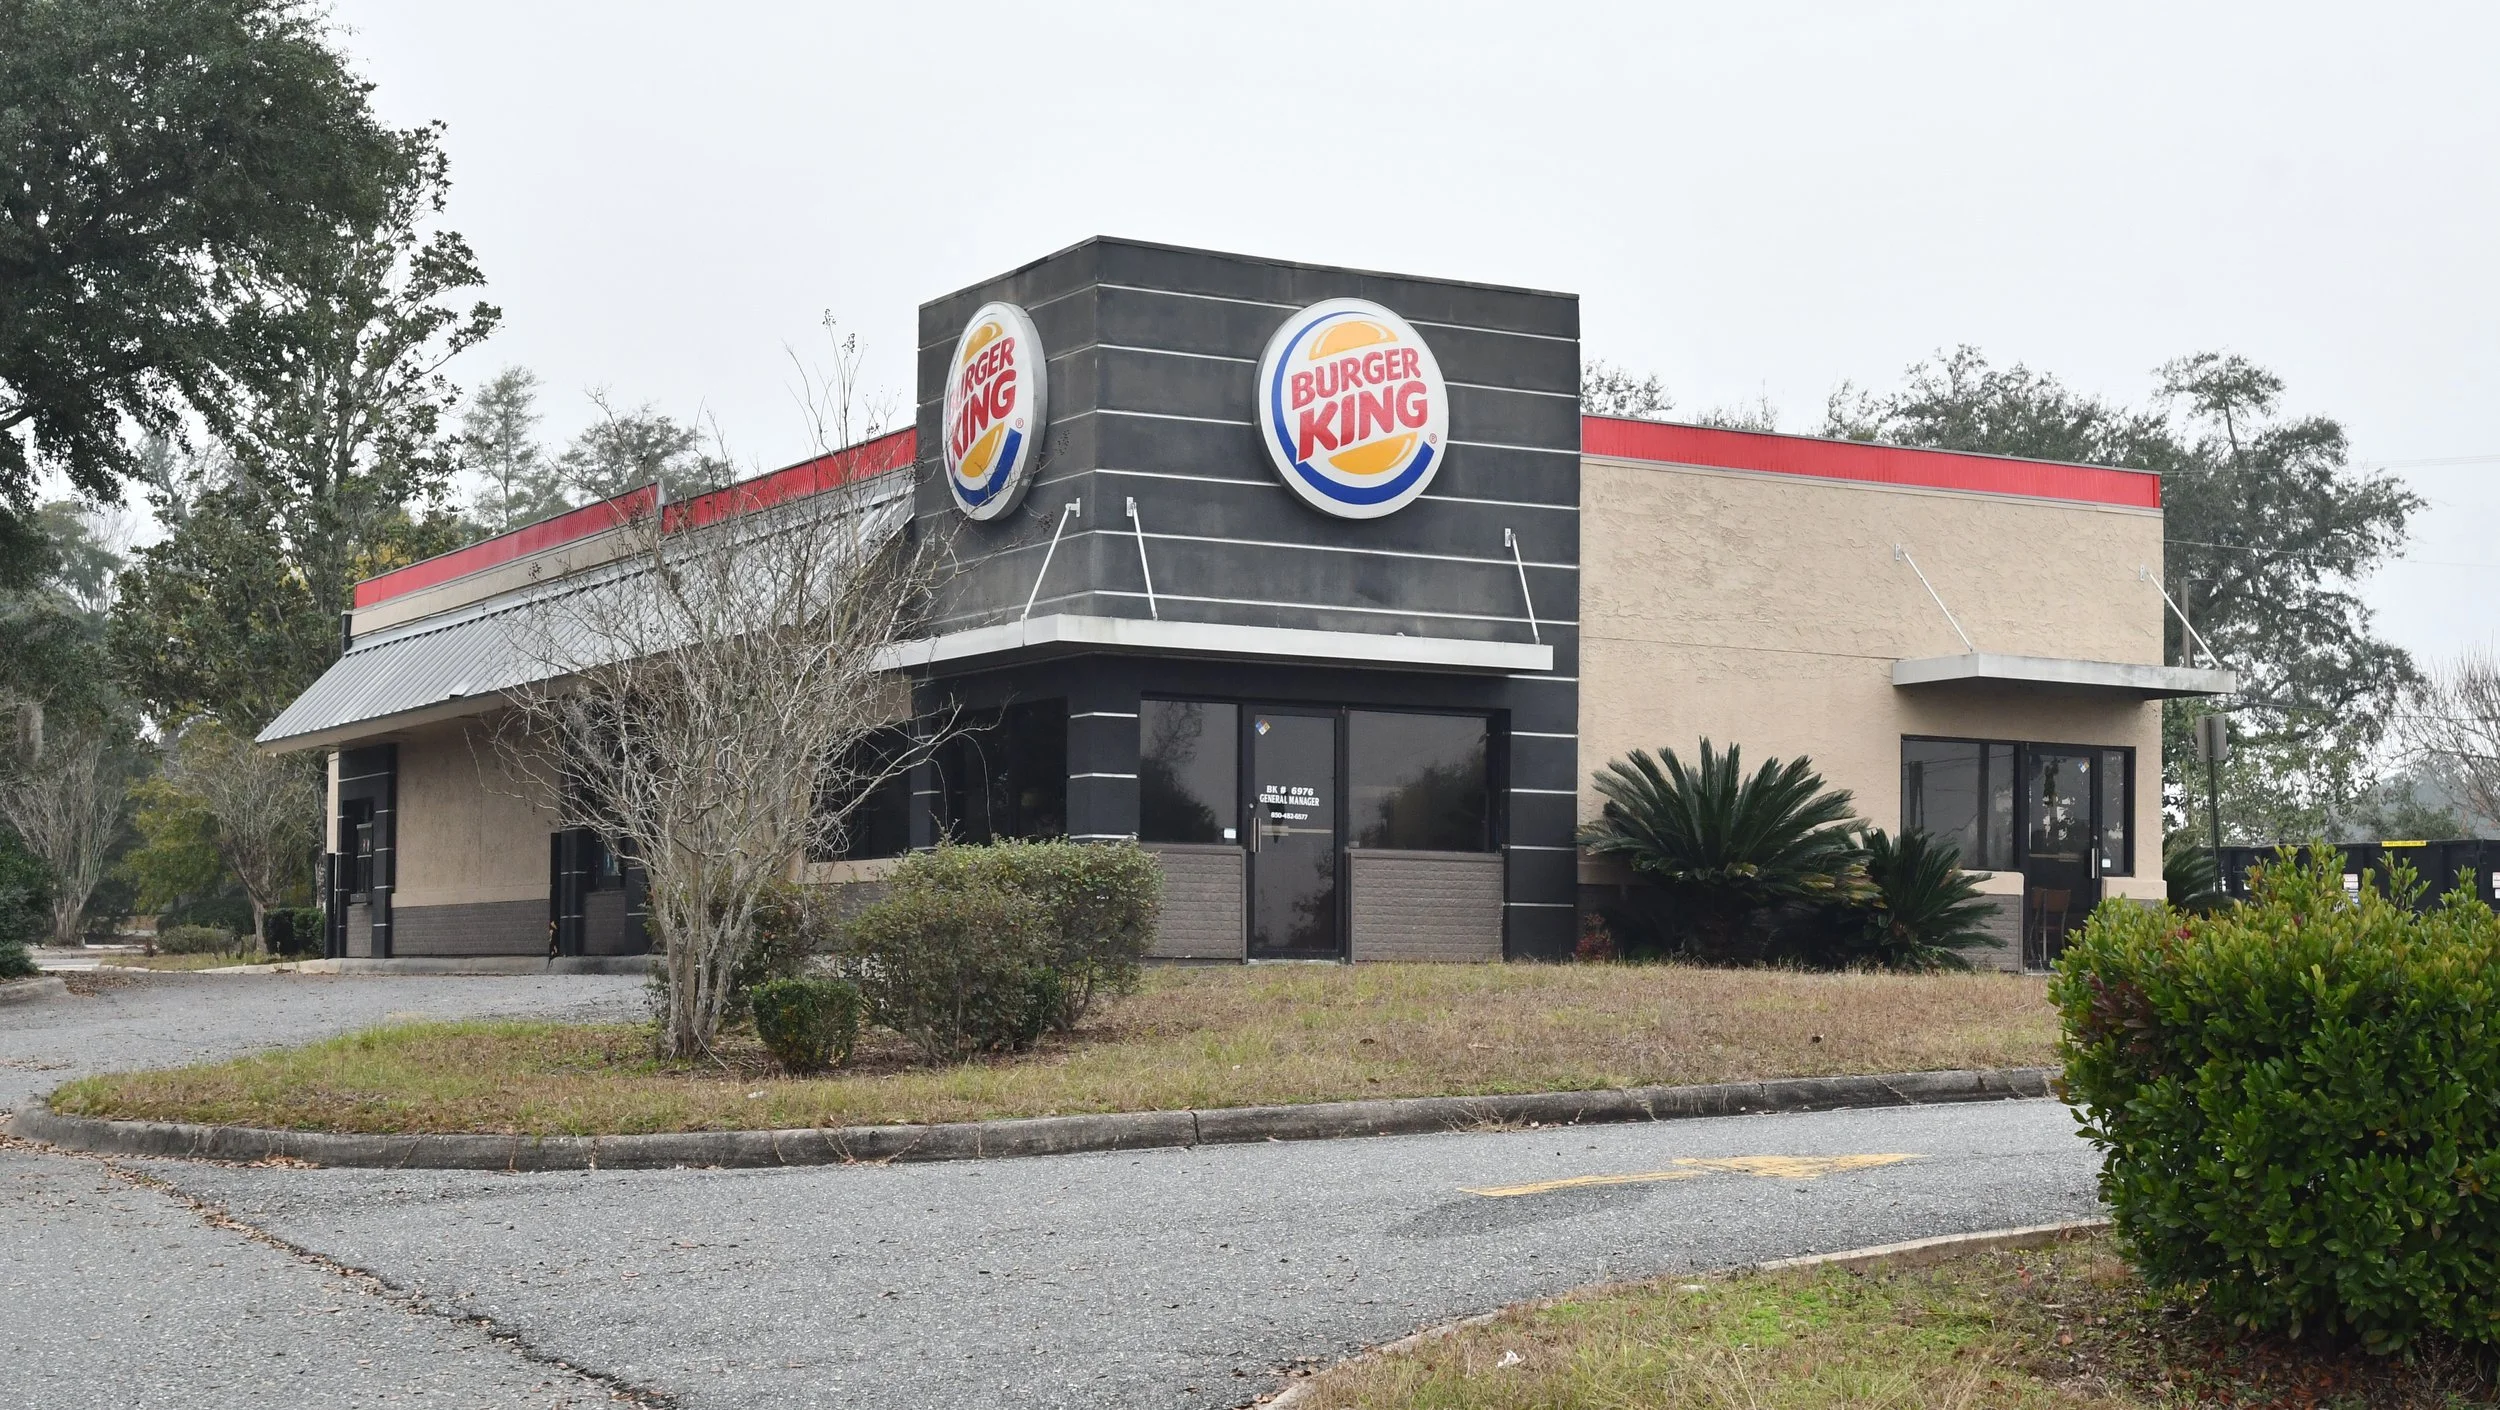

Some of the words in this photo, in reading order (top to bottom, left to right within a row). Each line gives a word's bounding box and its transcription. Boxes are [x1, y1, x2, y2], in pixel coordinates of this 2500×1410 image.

[1291, 347, 1422, 411] BURGER
[951, 369, 1017, 475] KING
[1297, 380, 1429, 462] KING
[1260, 794, 1288, 804] GENERAL
[1289, 795, 1320, 806] MANAGER
[1266, 785, 1278, 793] BK
[1291, 787, 1314, 796] 6976
